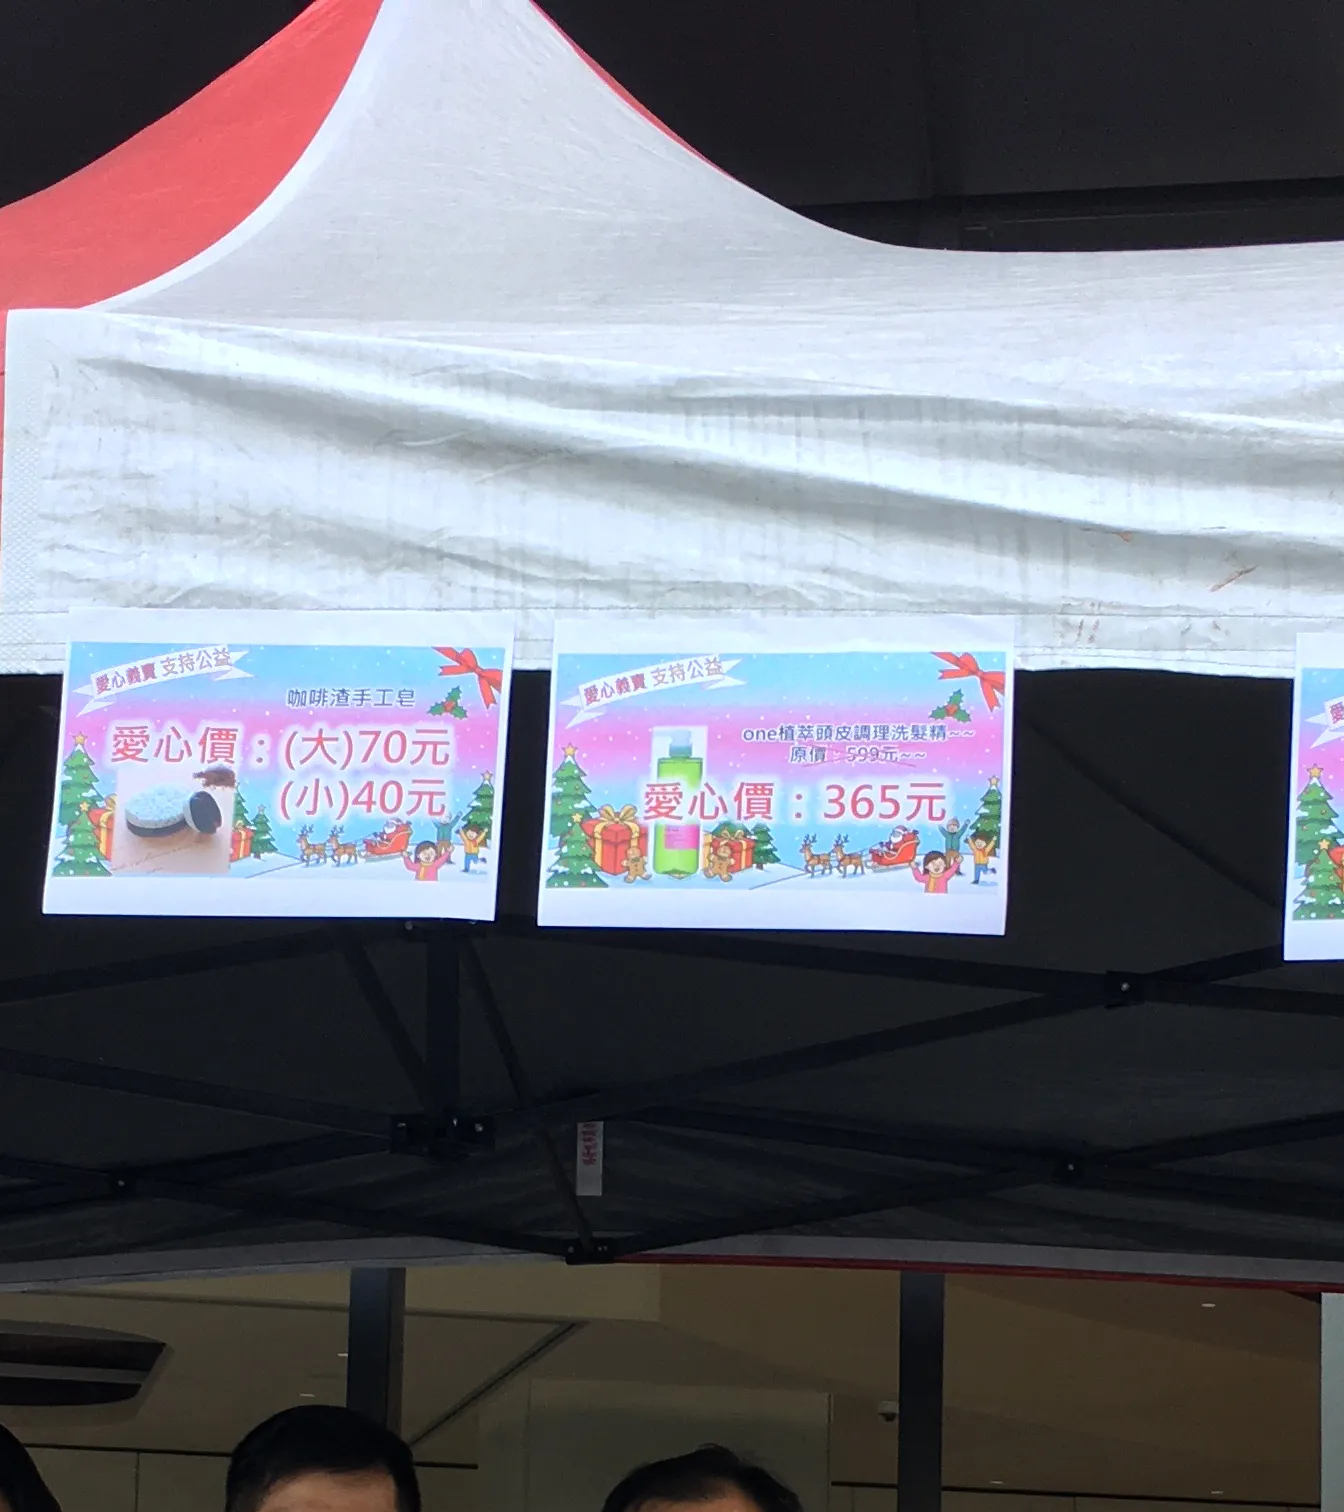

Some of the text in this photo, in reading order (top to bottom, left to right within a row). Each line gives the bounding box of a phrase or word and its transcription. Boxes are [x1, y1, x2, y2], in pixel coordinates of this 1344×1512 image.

[160, 646, 232, 677] 支持公益
[651, 655, 724, 688] 支持公益
[286, 686, 416, 709] 咖啡渣手工皂
[279, 777, 447, 820] (小)40元
